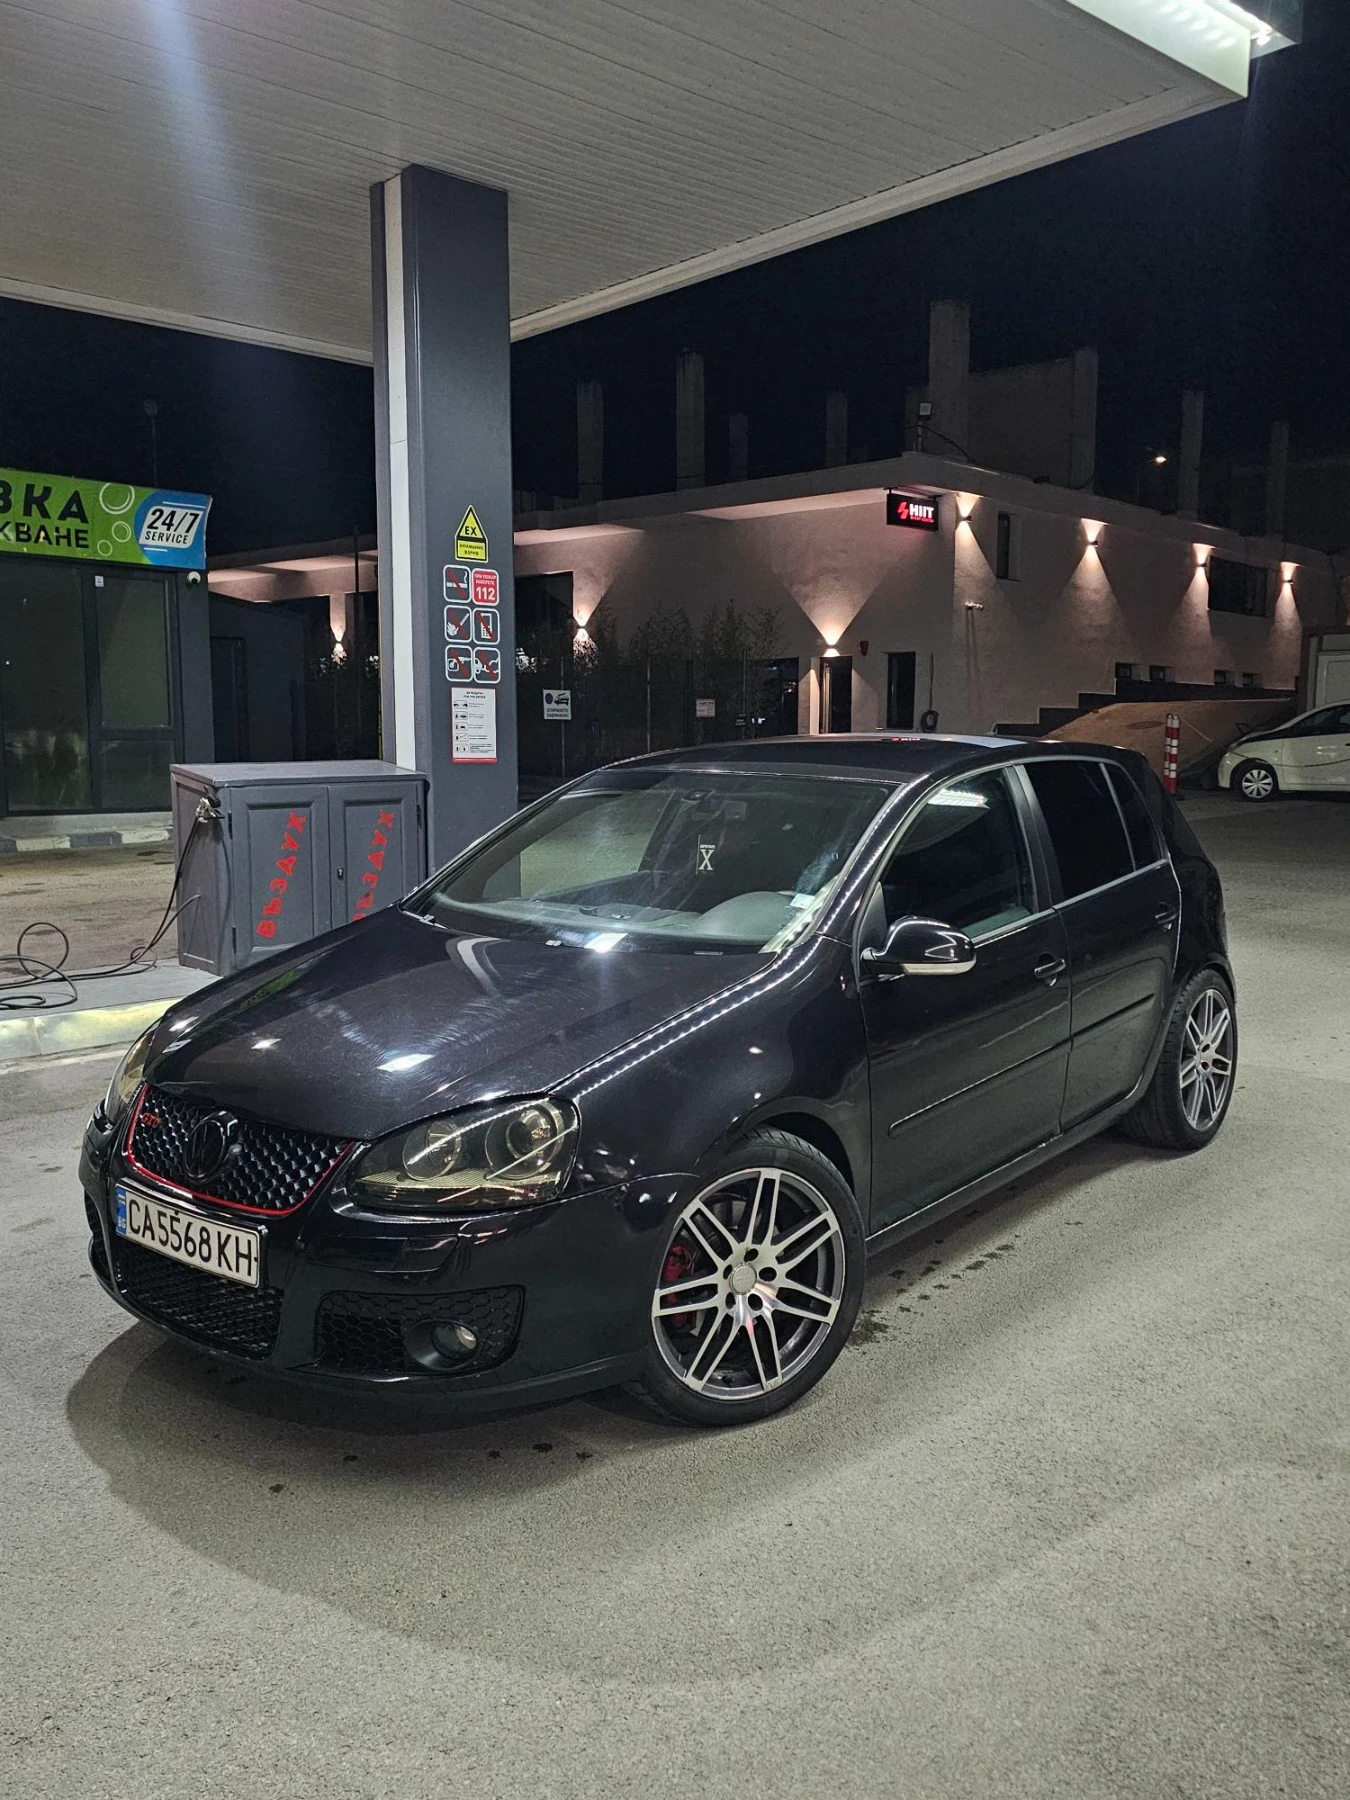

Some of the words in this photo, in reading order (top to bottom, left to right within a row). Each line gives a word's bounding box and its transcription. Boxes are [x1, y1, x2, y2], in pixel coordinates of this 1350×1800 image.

[909, 503, 934, 519] HIIT
[147, 508, 200, 534] 24/7
[145, 530, 189, 545] SERVICE
[476, 586, 496, 600] 112
